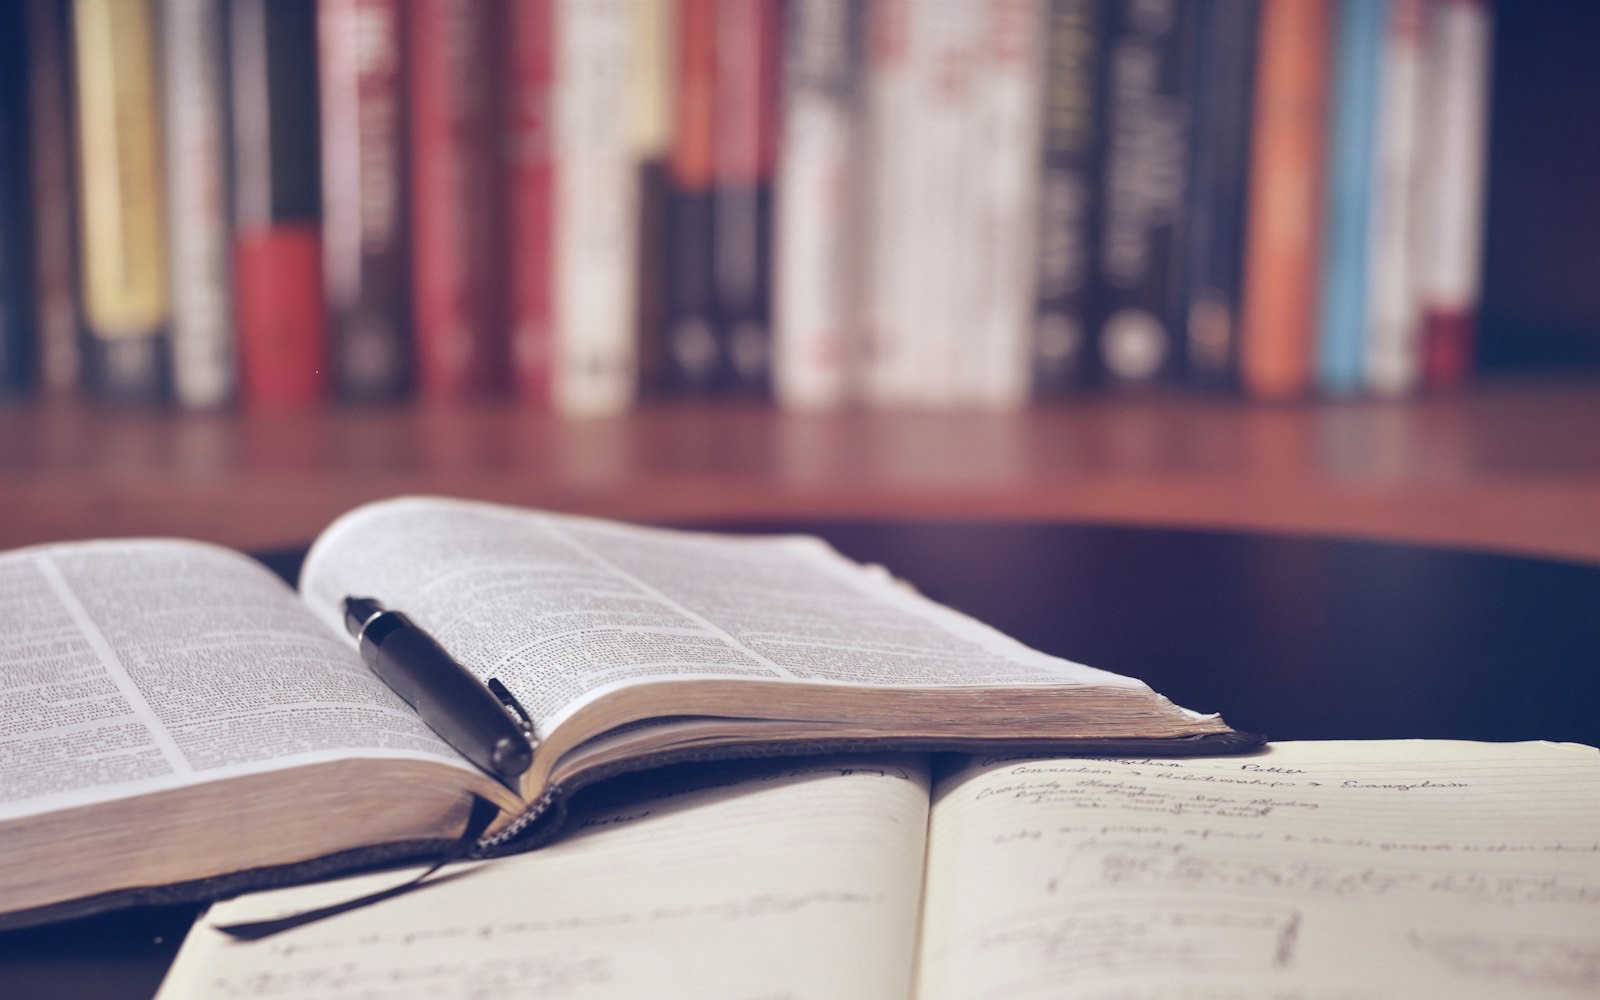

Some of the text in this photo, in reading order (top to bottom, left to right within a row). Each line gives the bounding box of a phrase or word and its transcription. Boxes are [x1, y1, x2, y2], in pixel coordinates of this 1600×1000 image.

[1241, 763, 1307, 774] Potter
[1010, 766, 1469, 791] Connection Relationships Evangelism
